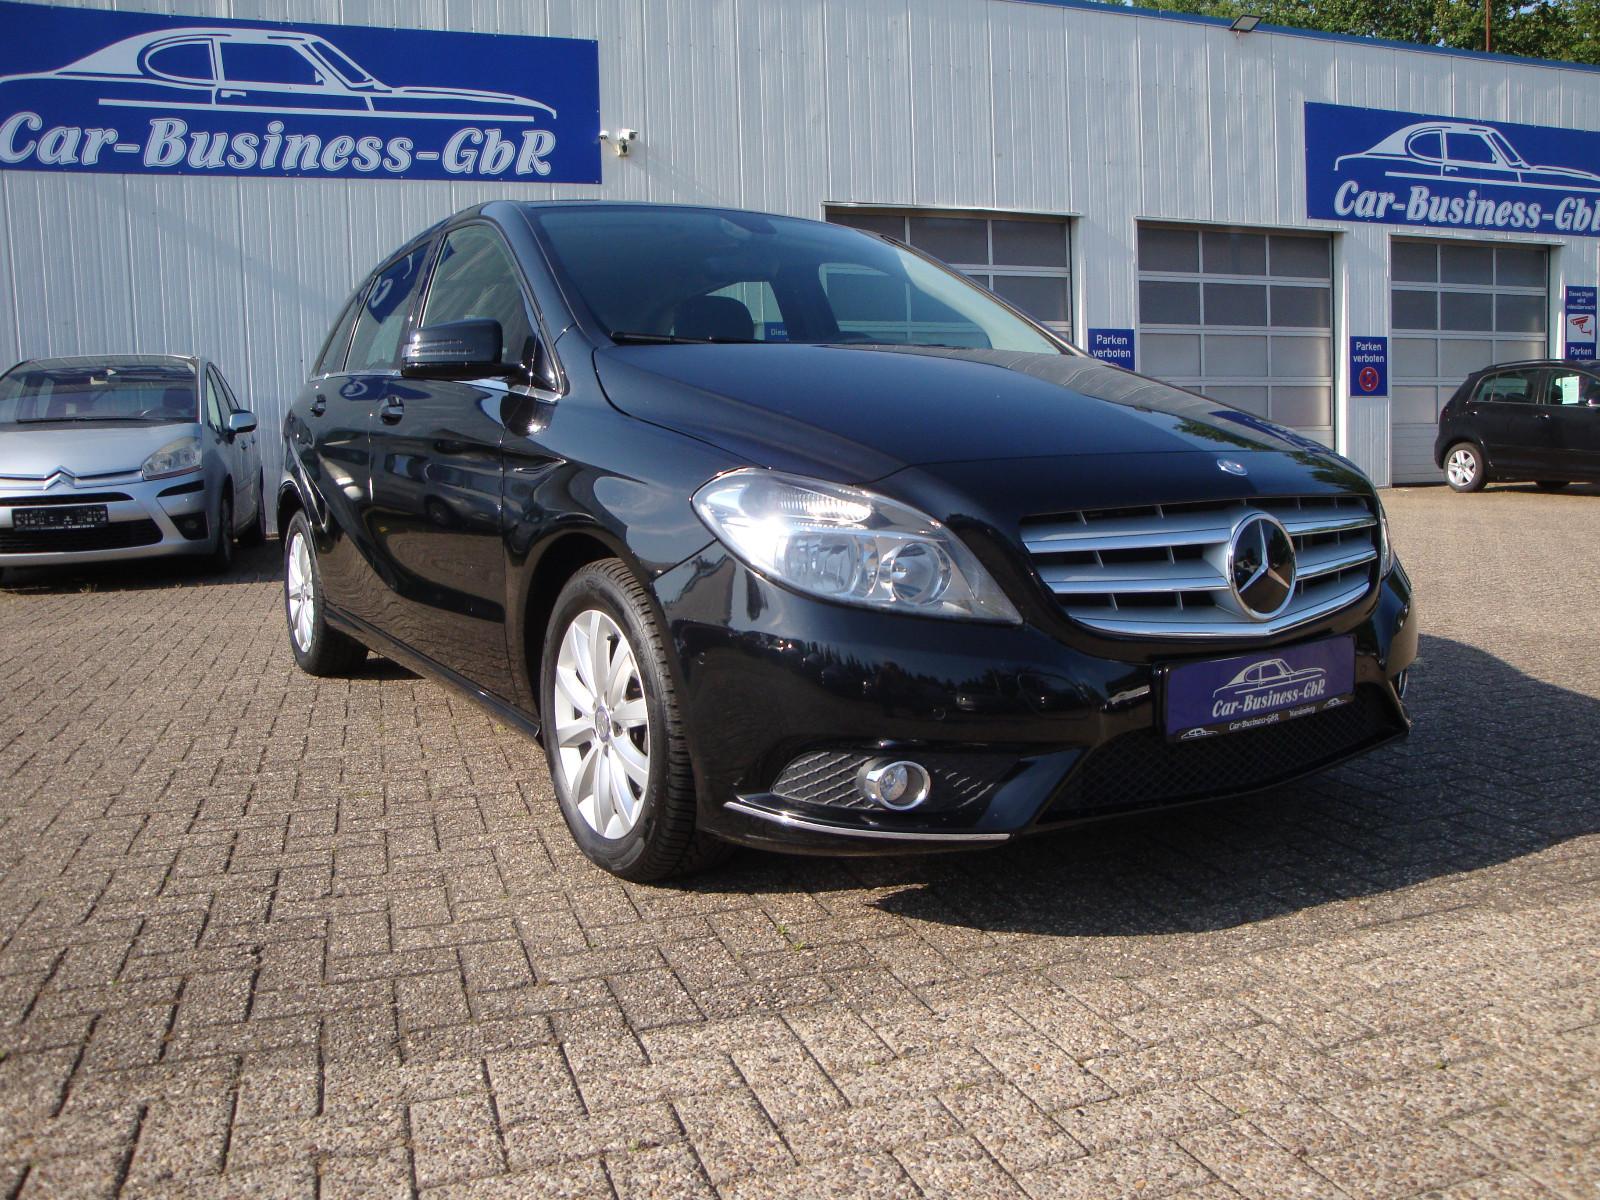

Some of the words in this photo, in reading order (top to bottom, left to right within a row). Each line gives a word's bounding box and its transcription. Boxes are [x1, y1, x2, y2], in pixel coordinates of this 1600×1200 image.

[0, 111, 557, 176] Car-Business-GbR
[1096, 334, 1128, 345] Parken
[1355, 341, 1382, 351] Parken
[1570, 346, 1592, 356] Parken
[1092, 347, 1131, 358] verboten
[1352, 354, 1385, 363] verboten
[1212, 679, 1326, 718] Car-Business-GbR
